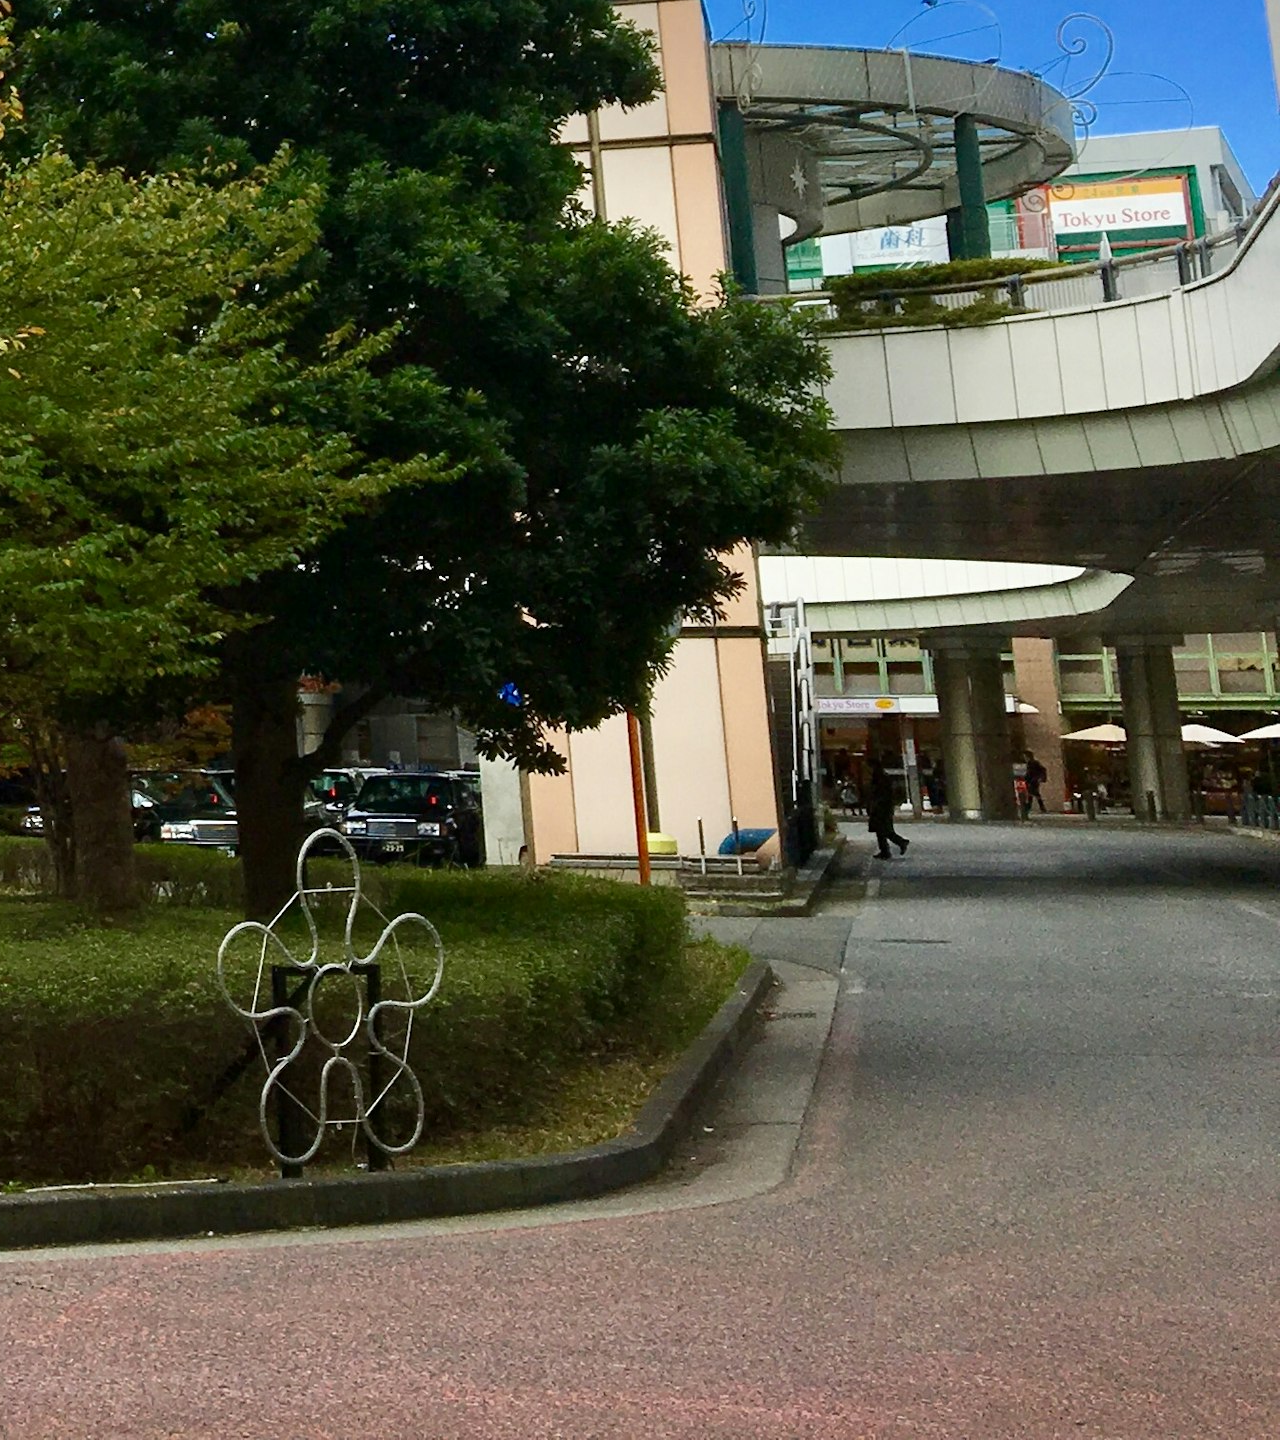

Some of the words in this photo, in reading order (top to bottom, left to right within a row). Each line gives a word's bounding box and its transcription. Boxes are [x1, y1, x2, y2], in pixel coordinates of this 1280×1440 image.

[1058, 212, 1117, 228] Tokyu
[1121, 208, 1171, 223] Store
[845, 700, 870, 709] Store
